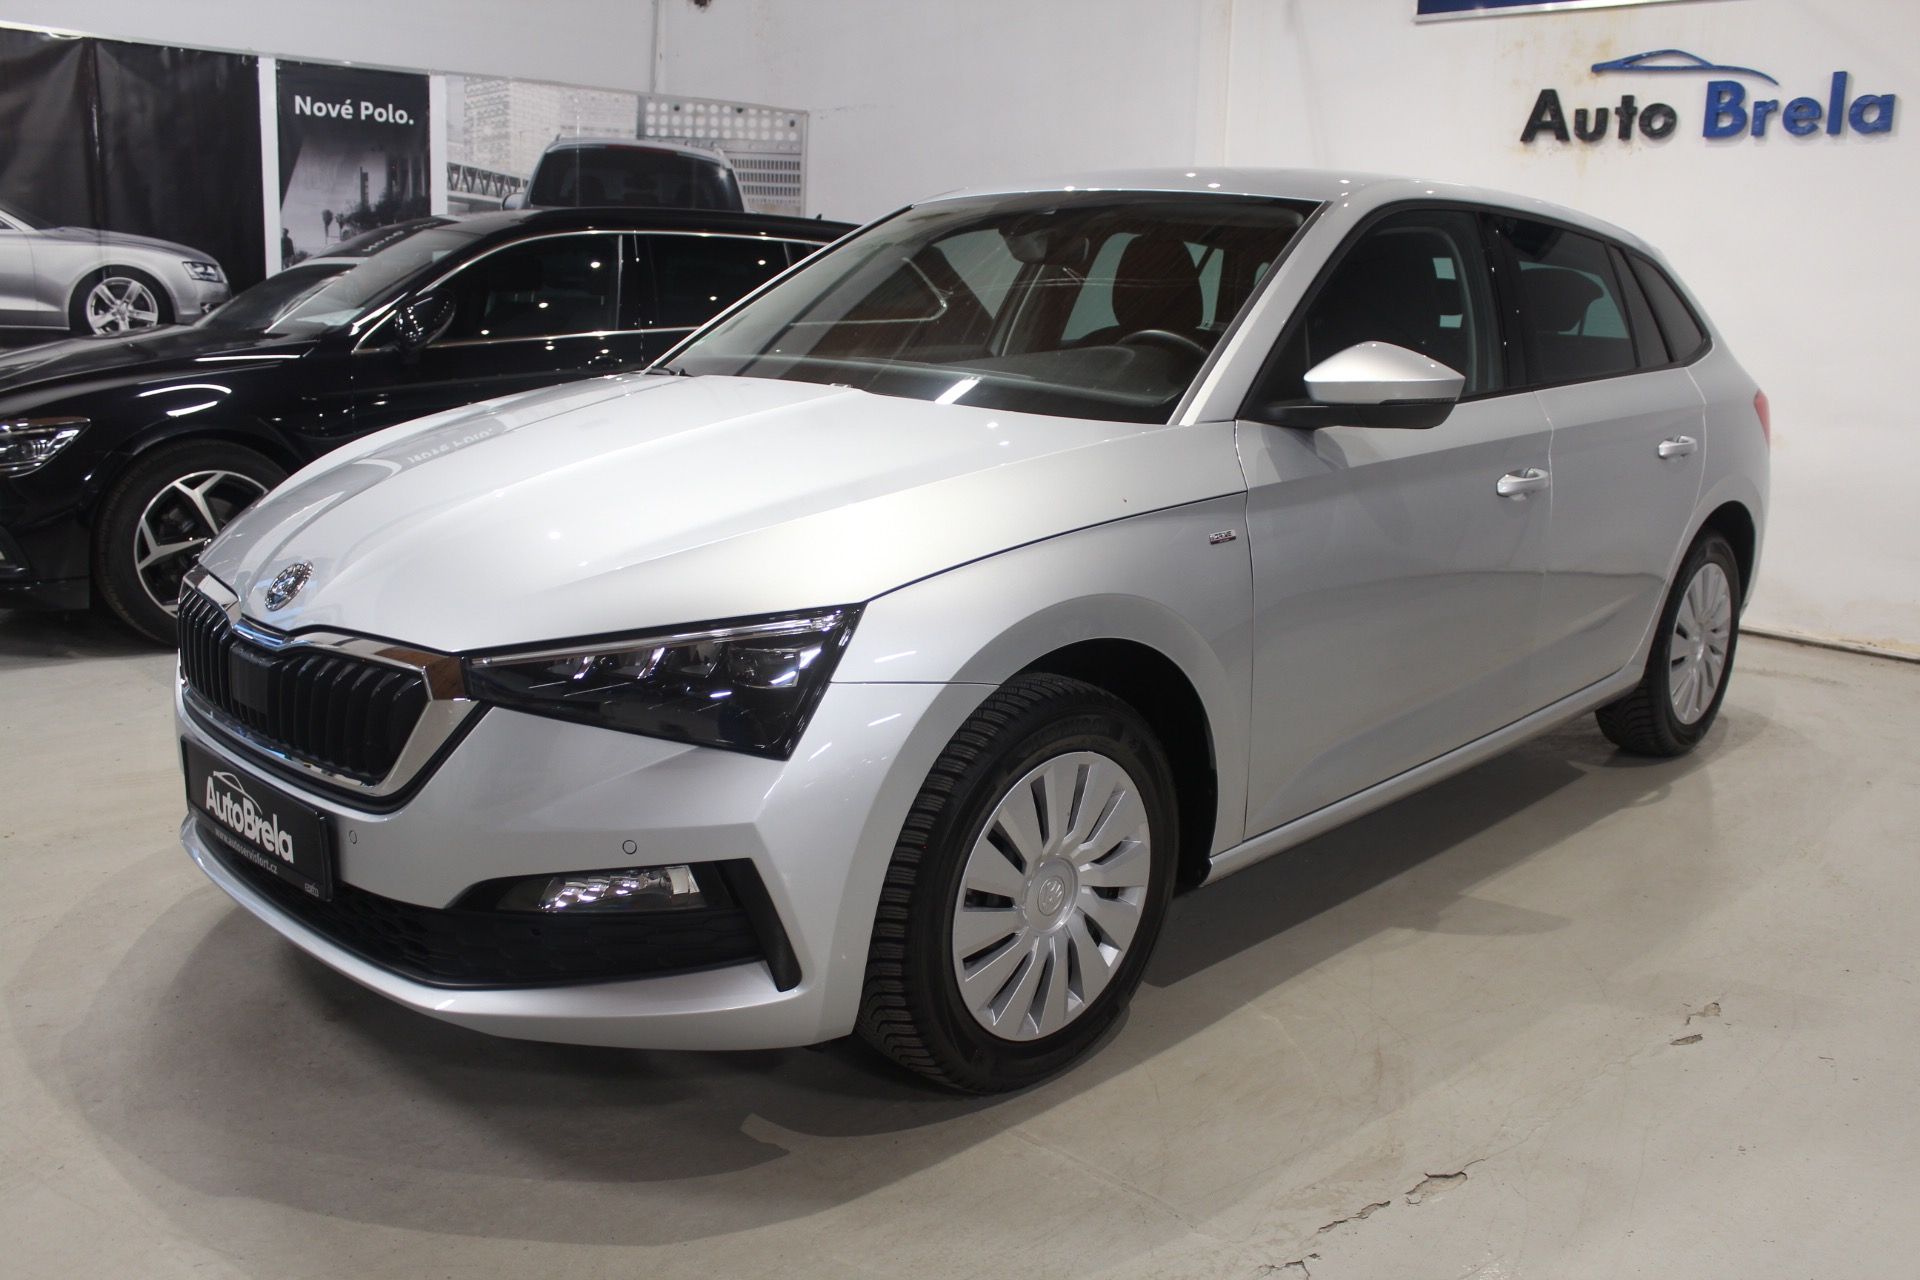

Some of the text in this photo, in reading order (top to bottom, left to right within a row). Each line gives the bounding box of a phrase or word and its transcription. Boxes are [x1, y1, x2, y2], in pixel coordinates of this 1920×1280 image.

[294, 95, 414, 125] Nové Polo.
[1520, 71, 1896, 143] Auto Brela
[206, 776, 294, 864] AutoBrela
